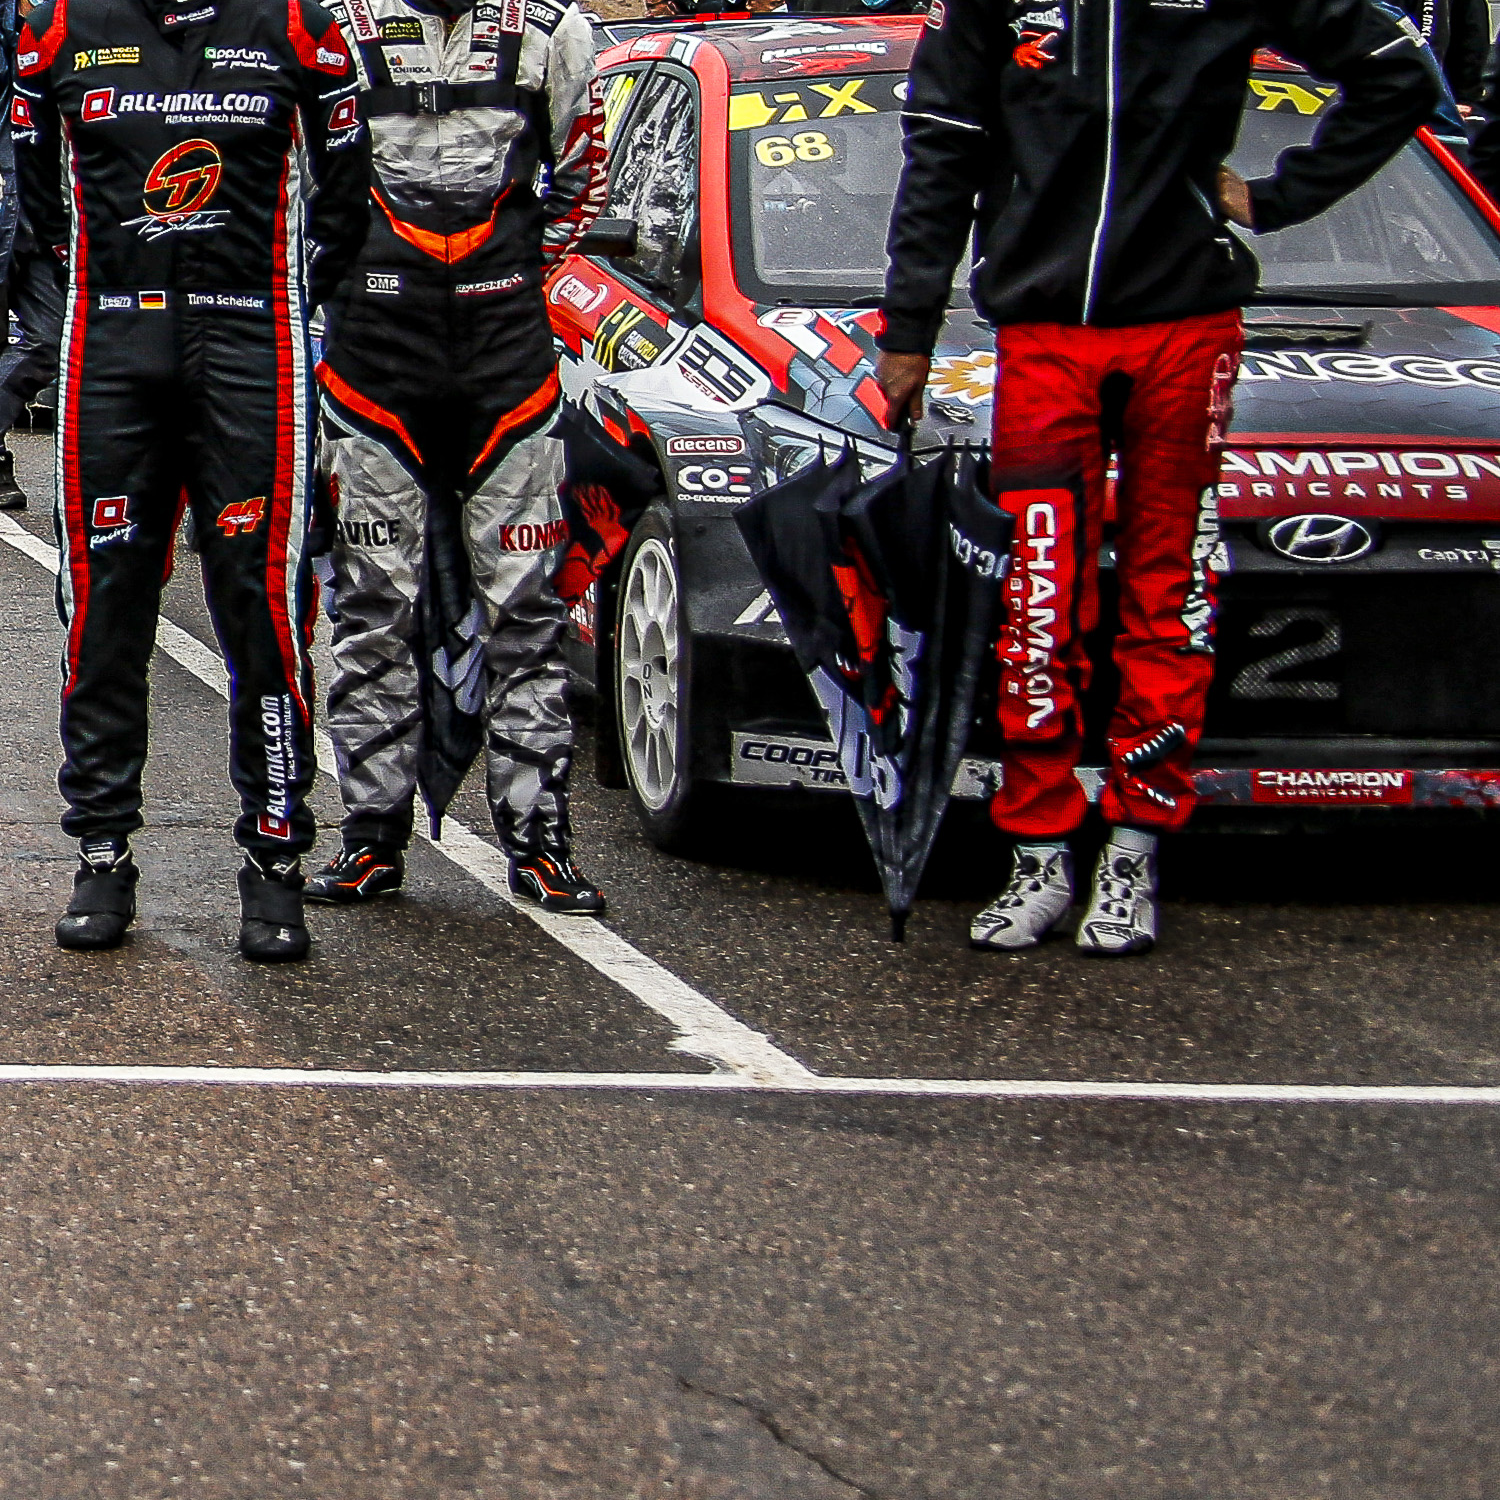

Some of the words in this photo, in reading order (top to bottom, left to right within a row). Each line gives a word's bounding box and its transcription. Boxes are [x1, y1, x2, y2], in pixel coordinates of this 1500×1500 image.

[755, 131, 835, 168] 68
[366, 277, 399, 291] OMP
[187, 293, 214, 305] Timo
[673, 438, 738, 451] decens
[1219, 450, 1500, 479] AMPION
[1218, 483, 1469, 500] BRICANTS
[216, 496, 266, 537] 44
[336, 518, 400, 547] RVICE
[1026, 502, 1058, 730] CHAMPION
[1230, 607, 1341, 699] 2
[739, 741, 842, 767] COOP
[810, 766, 847, 783] TIR
[1258, 769, 1405, 789] CHAMPION
